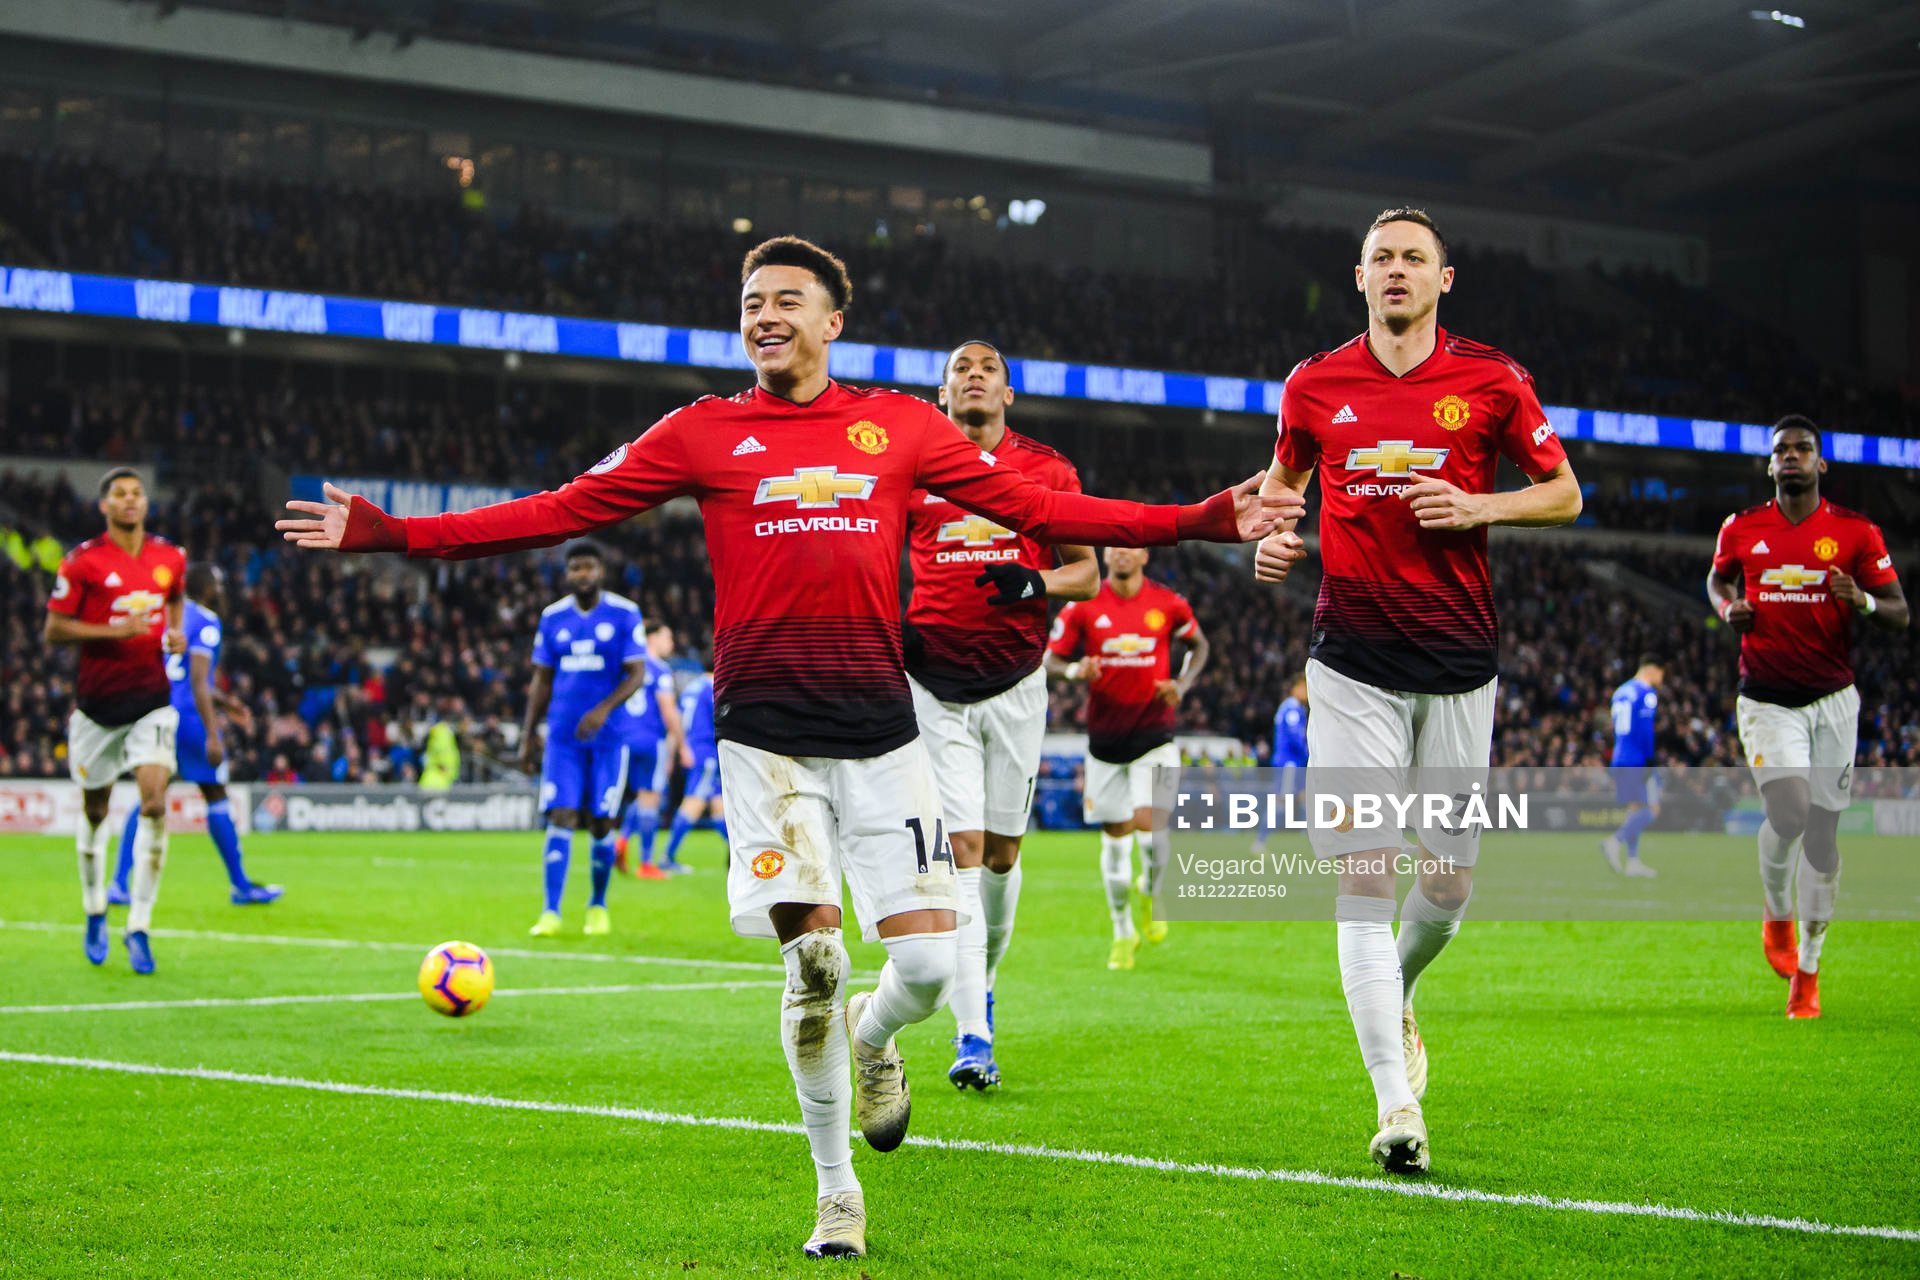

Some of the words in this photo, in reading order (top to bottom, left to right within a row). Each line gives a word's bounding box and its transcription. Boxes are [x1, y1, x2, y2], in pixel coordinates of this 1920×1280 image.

[219, 287, 327, 334] MALAYSIA
[458, 308, 559, 353] MALAYSIA
[732, 445, 767, 456] adidas
[1346, 484, 1412, 496] CHEVR
[755, 517, 879, 536] CHEVROLET
[936, 549, 1020, 563] CHEVROLET
[1759, 592, 1827, 602] CHEVROLET
[288, 796, 419, 830] Domino's
[423, 794, 533, 830] Cardiff
[905, 817, 955, 876] 14
